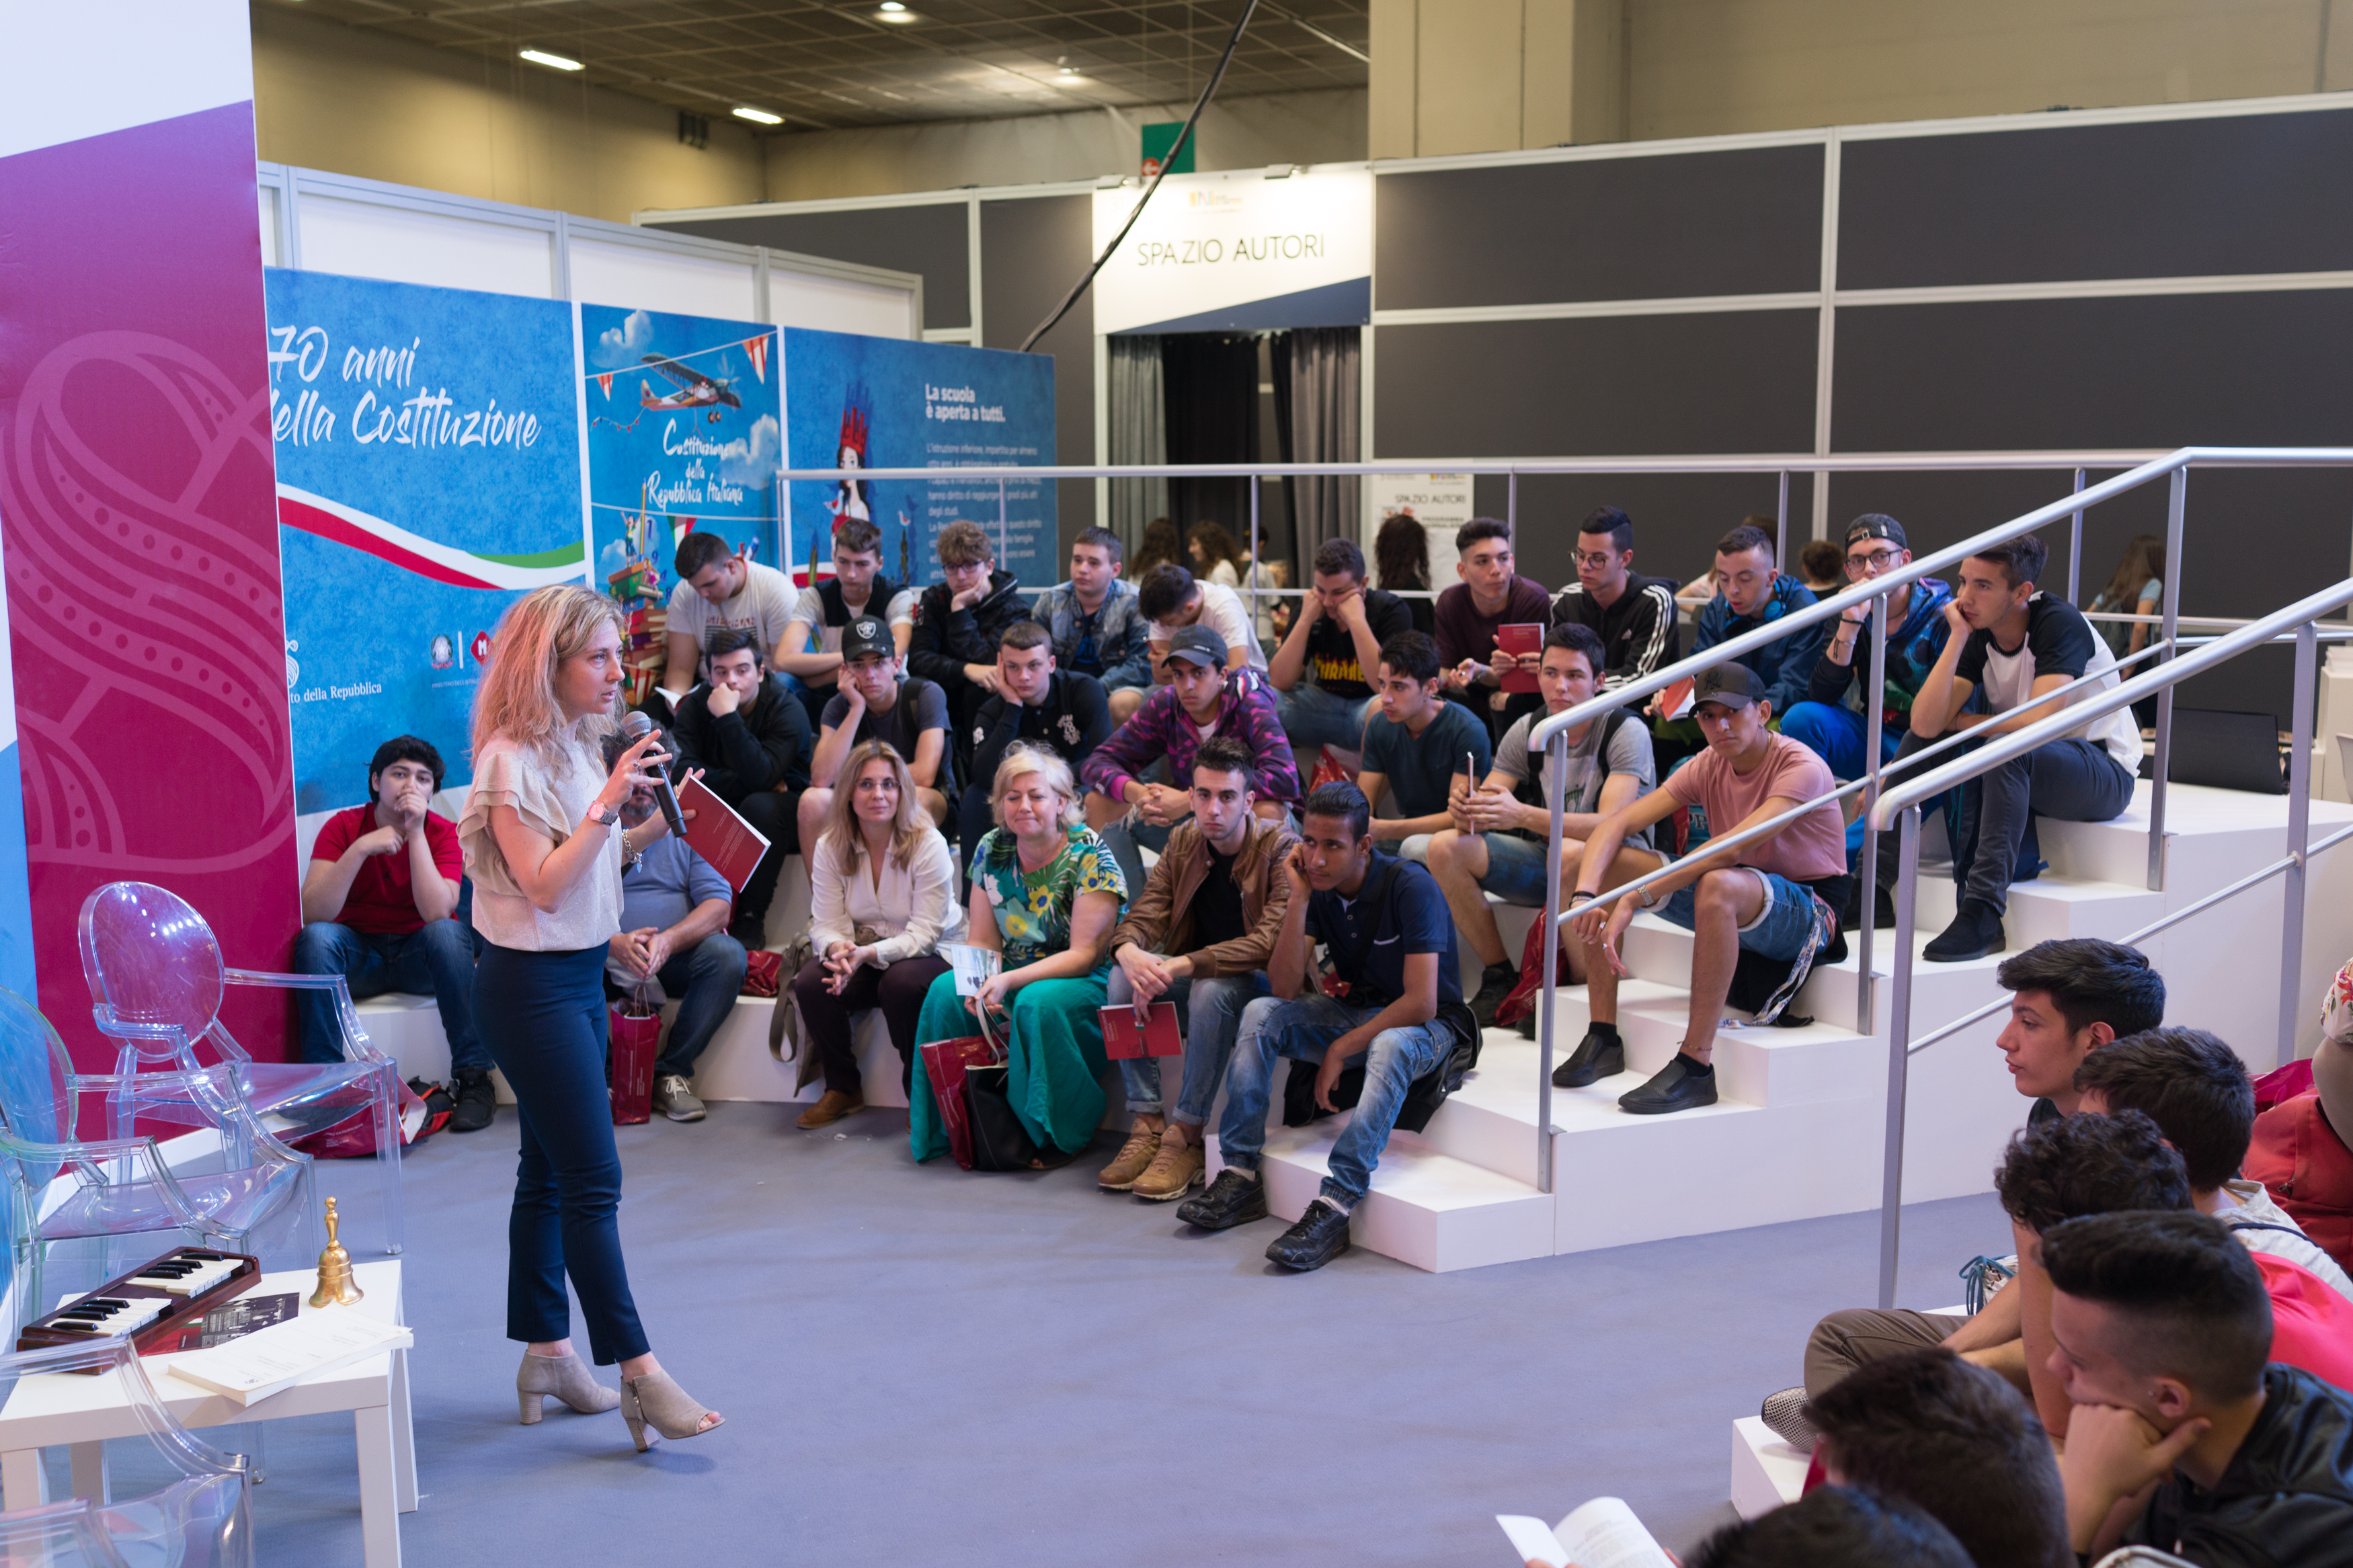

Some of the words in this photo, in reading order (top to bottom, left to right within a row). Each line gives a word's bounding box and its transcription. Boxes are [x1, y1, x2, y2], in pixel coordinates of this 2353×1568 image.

[1138, 239, 1223, 267] SPAZIO
[1233, 234, 1325, 262] AUTORI
[268, 325, 329, 382] 70
[342, 336, 421, 389] anni
[925, 383, 940, 401] La
[941, 385, 976, 403] scuola
[352, 386, 542, 450] Costituzione
[925, 401, 934, 419] è
[935, 403, 971, 423] aperta
[971, 407, 980, 421] a
[980, 405, 1006, 423] tutti.
[662, 417, 729, 461] Costituzione
[685, 458, 705, 480] della
[646, 470, 703, 513] Repubblica
[1395, 494, 1429, 504] SPAZIO
[1431, 493, 1466, 504] AUTORI
[647, 519, 653, 539] 1
[651, 550, 658, 565] 9
[665, 586, 672, 602] 8
[303, 687, 327, 702] della
[330, 681, 382, 700] Repubblica
